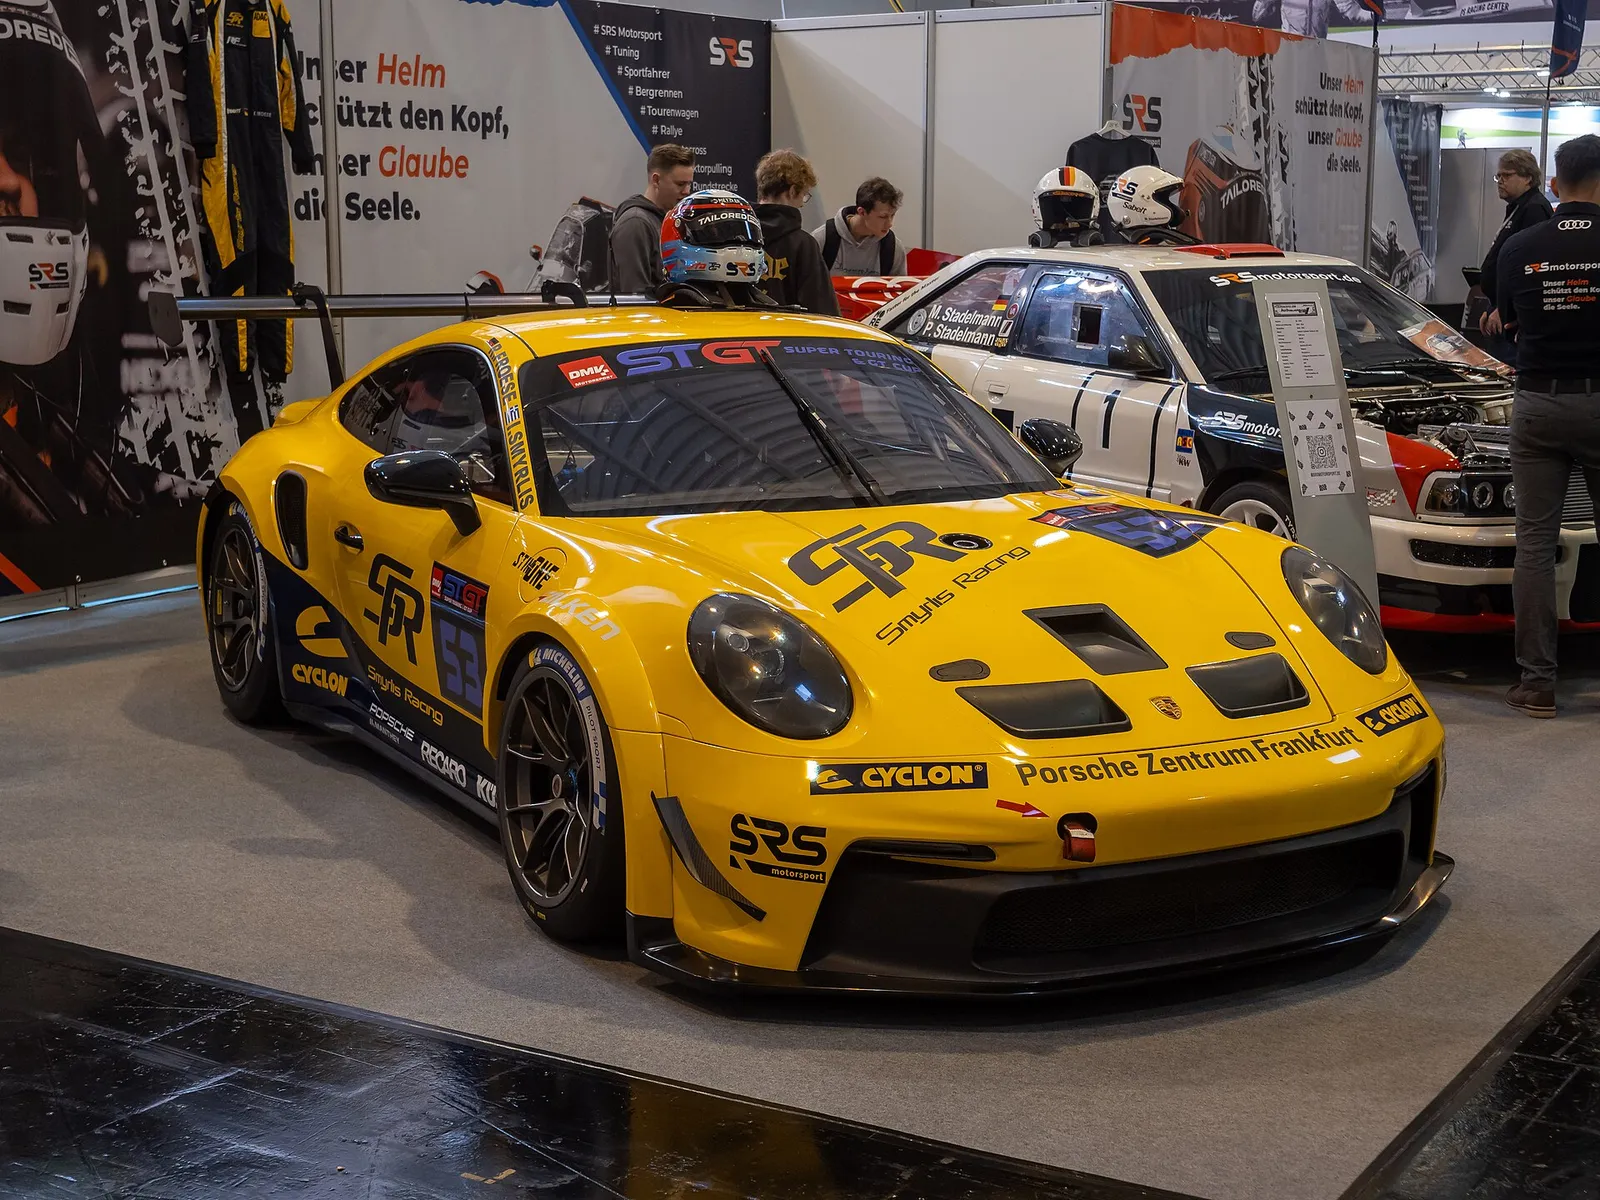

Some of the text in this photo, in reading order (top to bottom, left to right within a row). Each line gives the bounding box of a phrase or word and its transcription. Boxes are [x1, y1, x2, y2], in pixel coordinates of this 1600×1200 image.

[1487, 2, 1510, 11] CENTER
[601, 26, 617, 37] SRS
[618, 27, 663, 42] Motorsport
[612, 45, 640, 61] Tuning
[709, 36, 754, 69] SRS
[376, 53, 447, 89] Helm
[624, 66, 671, 80] Sportfahrer
[635, 86, 683, 100] Bergrennen
[1319, 72, 1365, 95] Unser Helm
[400, 100, 444, 131] den
[451, 104, 509, 140] Kopf,
[647, 105, 700, 120] Tourenwagen
[1122, 93, 1162, 132] SRS
[1294, 96, 1364, 124] schützt den Kopf,
[660, 125, 683, 138] Rallye
[1308, 127, 1363, 148] unser Glaube
[378, 145, 469, 179] Glaube
[1326, 152, 1362, 173] die Seele.
[345, 191, 421, 222] Seele.
[1122, 201, 1147, 215] Sabelt
[698, 212, 747, 226] TAILORED
[28, 262, 69, 282] SRS
[726, 262, 756, 277] SRS
[1209, 271, 1363, 288] SRSmotorsport.de
[1543, 287, 1572, 295] schützt
[928, 304, 1003, 328] M. Stadelmann
[922, 323, 996, 346] P. Stadelmann
[784, 346, 914, 365] SUPER TOURING
[867, 359, 887, 369] GT
[892, 363, 922, 374] CUP
[1103, 389, 1121, 450] 1
[952, 546, 1031, 590] Racing
[439, 618, 483, 709] 53
[543, 647, 586, 695] MICHELIN
[291, 663, 349, 697] CYCLON
[404, 687, 444, 727] Racing
[585, 704, 602, 770] PILOT SPORT
[420, 740, 468, 789] RECARO
[1015, 725, 1364, 787] Porsche Zentrum Frankfurt
[730, 813, 828, 867] SRS
[771, 867, 824, 882] motorsport
